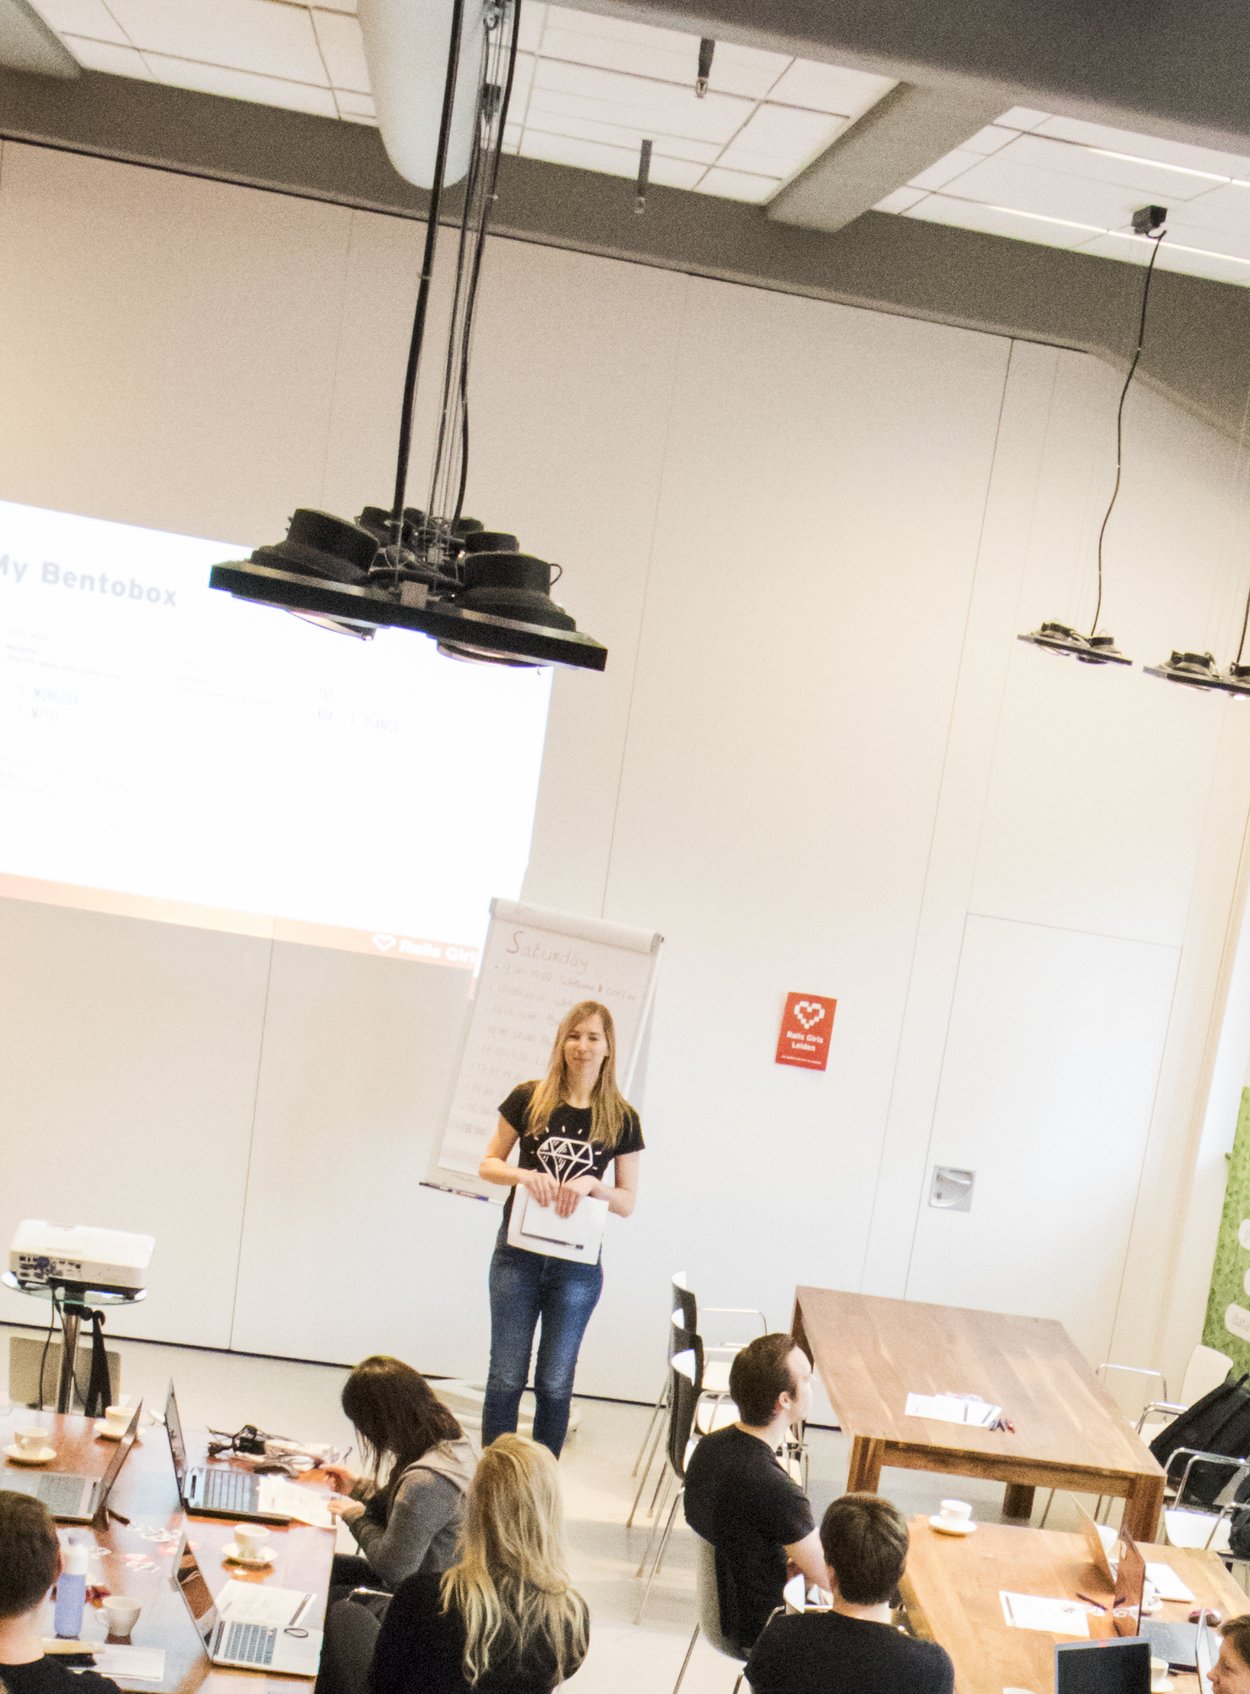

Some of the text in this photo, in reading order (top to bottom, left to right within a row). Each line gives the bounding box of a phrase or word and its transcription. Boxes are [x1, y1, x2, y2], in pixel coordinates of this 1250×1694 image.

[41, 561, 177, 607] Bentobox
[445, 946, 480, 963] Girl
[1231, 1313, 1250, 1332] data
